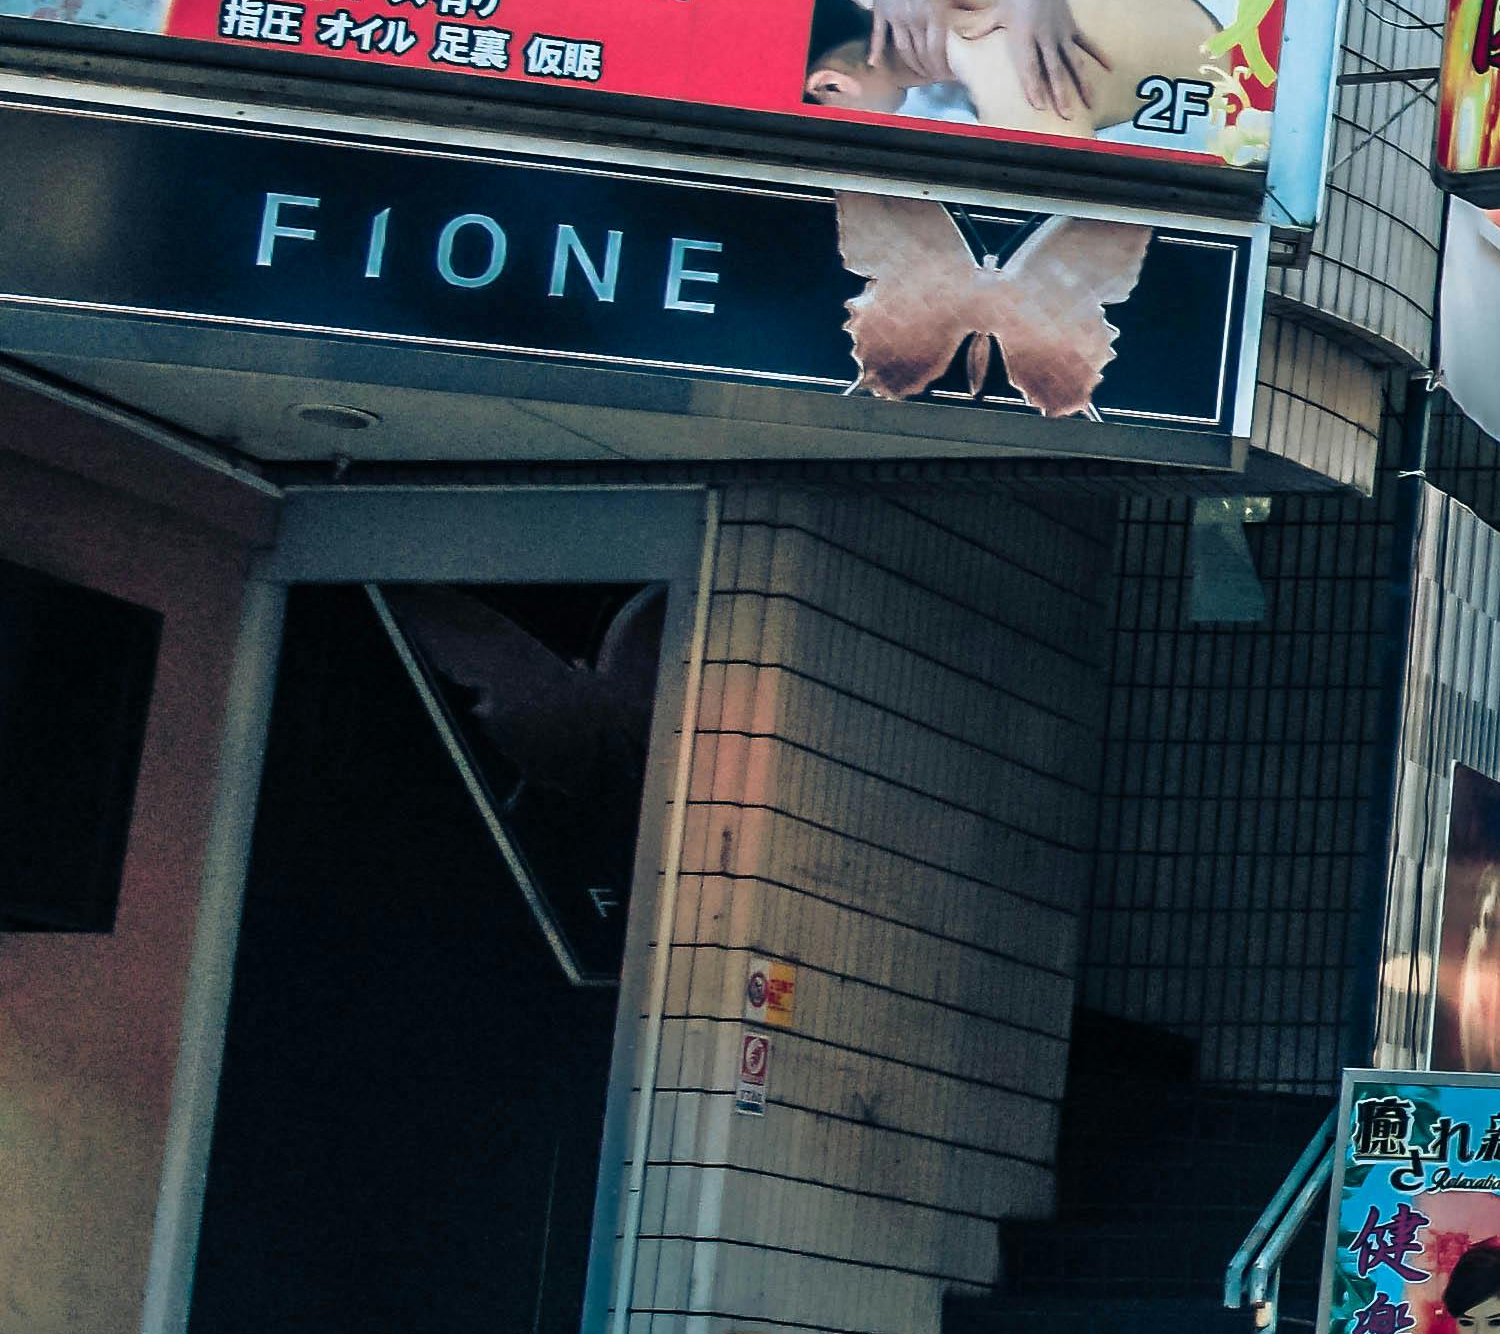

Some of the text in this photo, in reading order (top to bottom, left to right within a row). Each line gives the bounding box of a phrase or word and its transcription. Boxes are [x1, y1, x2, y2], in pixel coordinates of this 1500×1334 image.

[317, 9, 417, 59] オイル
[431, 22, 511, 73] 足裏
[525, 33, 604, 82] 仮眠
[1134, 77, 1212, 135] 2F
[254, 191, 727, 317] FIONE
